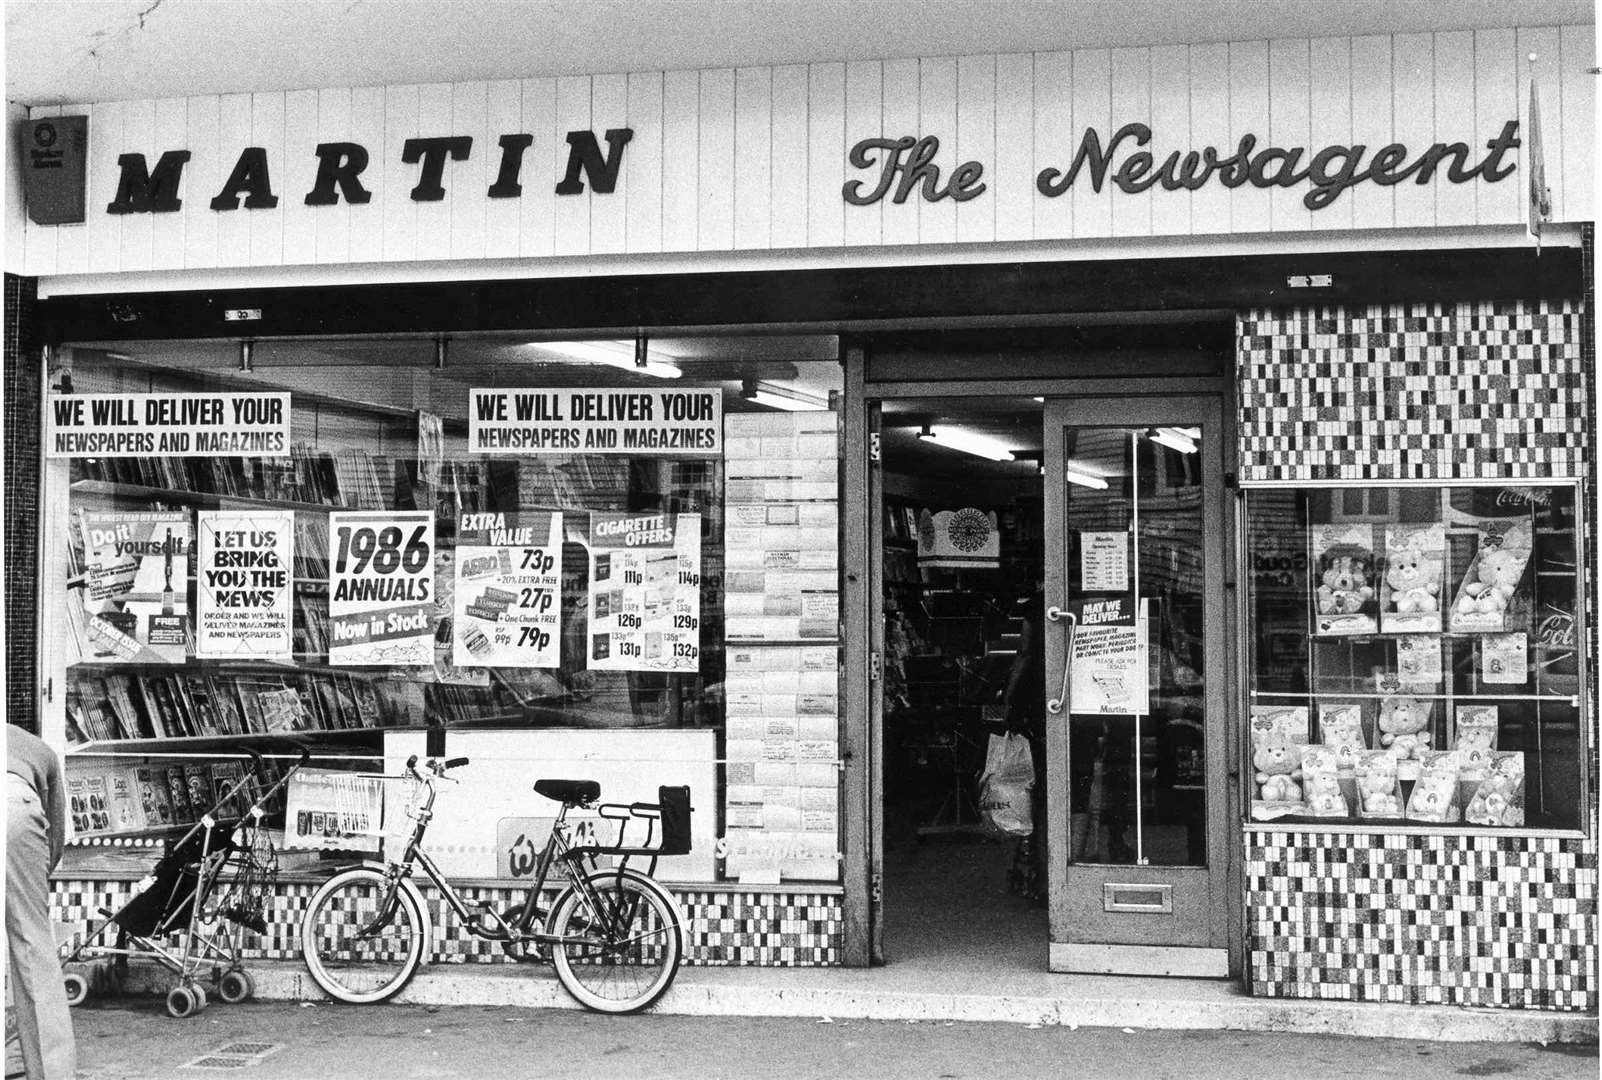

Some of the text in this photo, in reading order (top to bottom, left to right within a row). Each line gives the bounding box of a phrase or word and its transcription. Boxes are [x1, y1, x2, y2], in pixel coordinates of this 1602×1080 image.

[107, 128, 634, 214] MARTIN
[842, 119, 1522, 210] The Newsagent
[54, 398, 283, 426] WE WILL DELIVER YOUR
[476, 393, 713, 421] WE WILL DELIVER YOUR
[55, 431, 284, 453] NEWSPAPERS AND MAGAZINES
[478, 427, 715, 449] NEWSPAPERS AND MAGAZINES
[461, 512, 506, 531] EXTRA
[595, 515, 665, 537] CIGARETTE
[91, 524, 129, 547] Do it
[214, 531, 277, 548] LET US
[490, 527, 533, 546] VALUE
[625, 528, 673, 547] OFFERS
[115, 536, 184, 558] yourself
[335, 525, 430, 574] 1986
[214, 551, 278, 568] BRING
[520, 549, 554, 575] 73p
[205, 570, 247, 588] YOU
[250, 570, 286, 588] THE
[519, 576, 541, 584] EXTRA
[542, 576, 558, 584] FREE
[624, 570, 642, 586] 111p
[678, 571, 699, 587] 114p
[333, 577, 430, 602] ANNUALS
[216, 590, 275, 608] NEWS
[519, 588, 552, 613] 27p
[1082, 599, 1121, 615] MAY WE
[155, 617, 180, 626] FREE
[204, 612, 286, 620] ORDER AND WE WILL
[334, 609, 428, 641] Now in Stock
[504, 614, 518, 623] One
[519, 614, 539, 623] Chunk
[540, 614, 557, 624] FREE
[618, 613, 642, 630] 126p
[673, 615, 698, 631] 129p
[1082, 611, 1130, 625] DELIVER...
[209, 631, 281, 639] AND NEWSPAPERS
[495, 634, 511, 646] 99p
[517, 626, 550, 652] 79p
[620, 642, 641, 658] 131p
[673, 642, 698, 660] 132p
[1100, 705, 1128, 714] Martin
